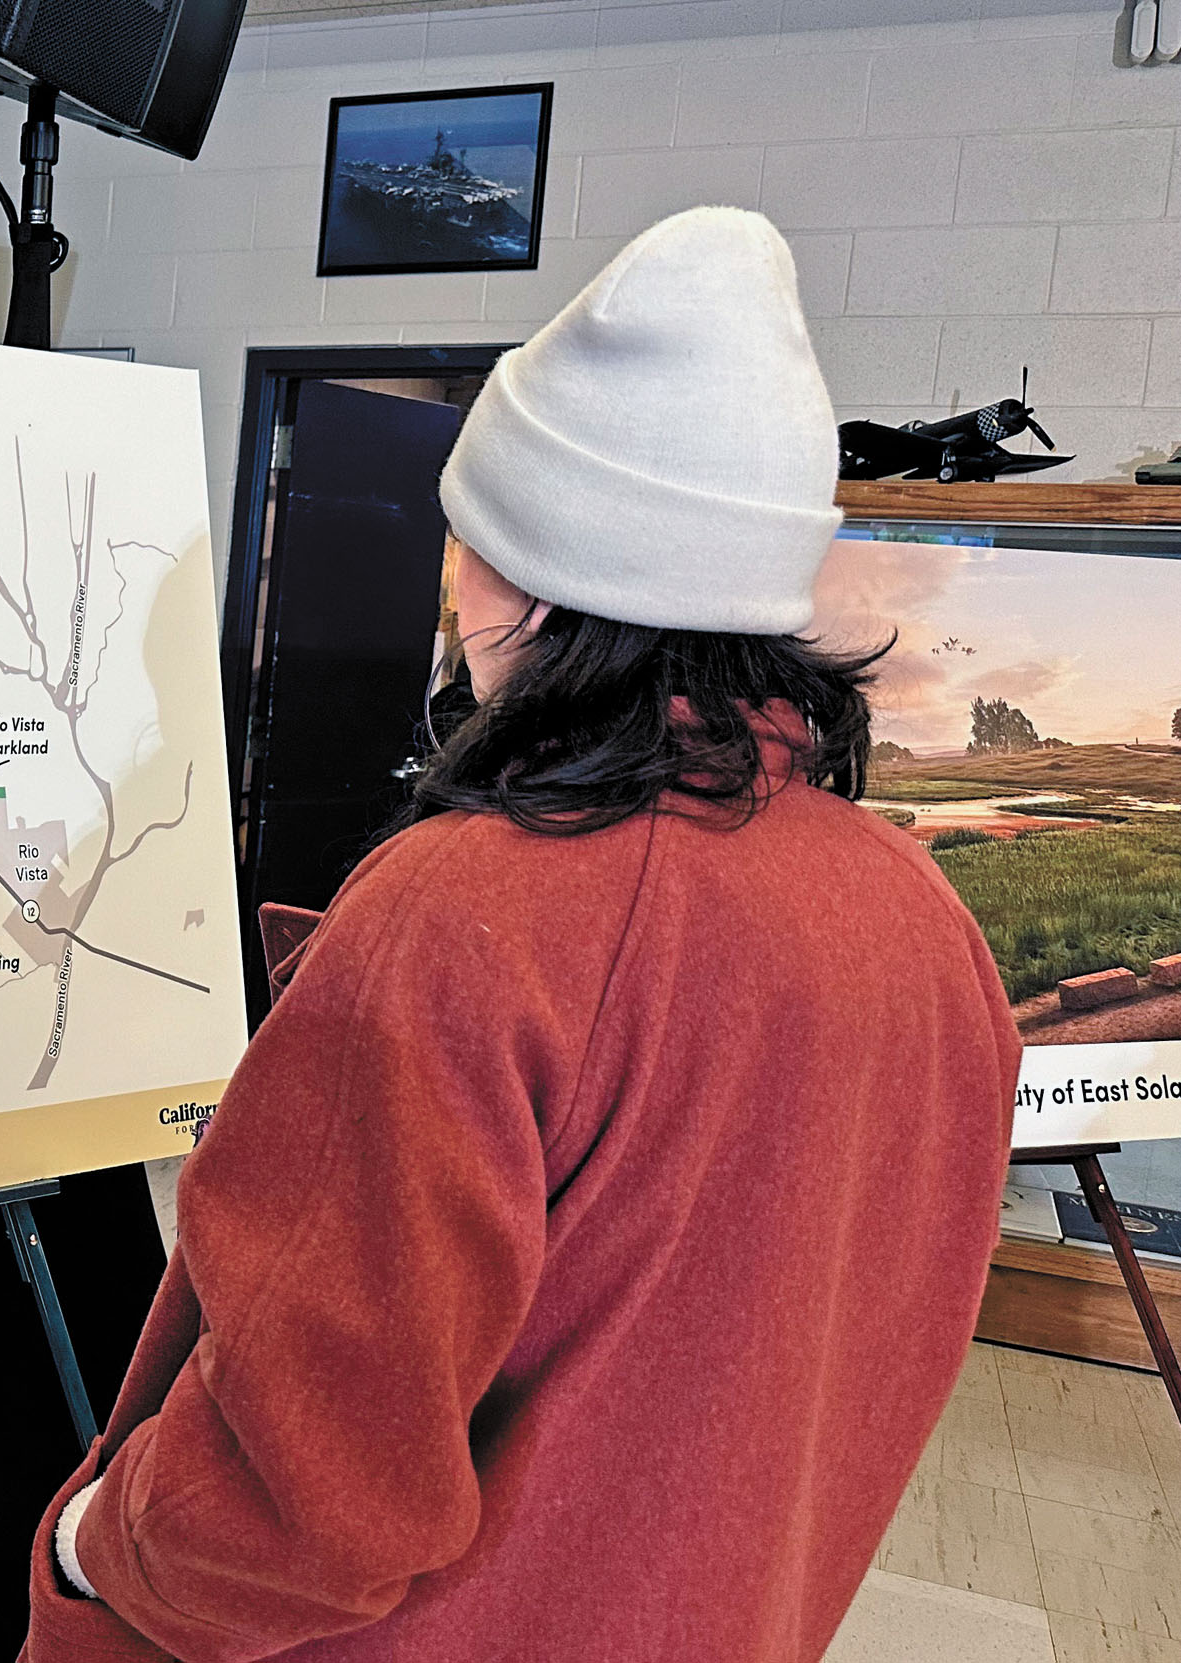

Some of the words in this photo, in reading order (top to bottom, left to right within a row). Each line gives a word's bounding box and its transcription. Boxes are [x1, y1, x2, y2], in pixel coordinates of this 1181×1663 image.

[75, 583, 86, 613] River
[69, 616, 84, 686] Sacramento
[12, 717, 45, 732] Vista
[19, 844, 39, 858] Rio
[16, 867, 48, 881] Vista
[27, 907, 35, 917] 12
[49, 983, 67, 1057] Sacramento
[60, 949, 73, 980] River
[1052, 1079, 1074, 1104] of
[1081, 1079, 1129, 1103] East
